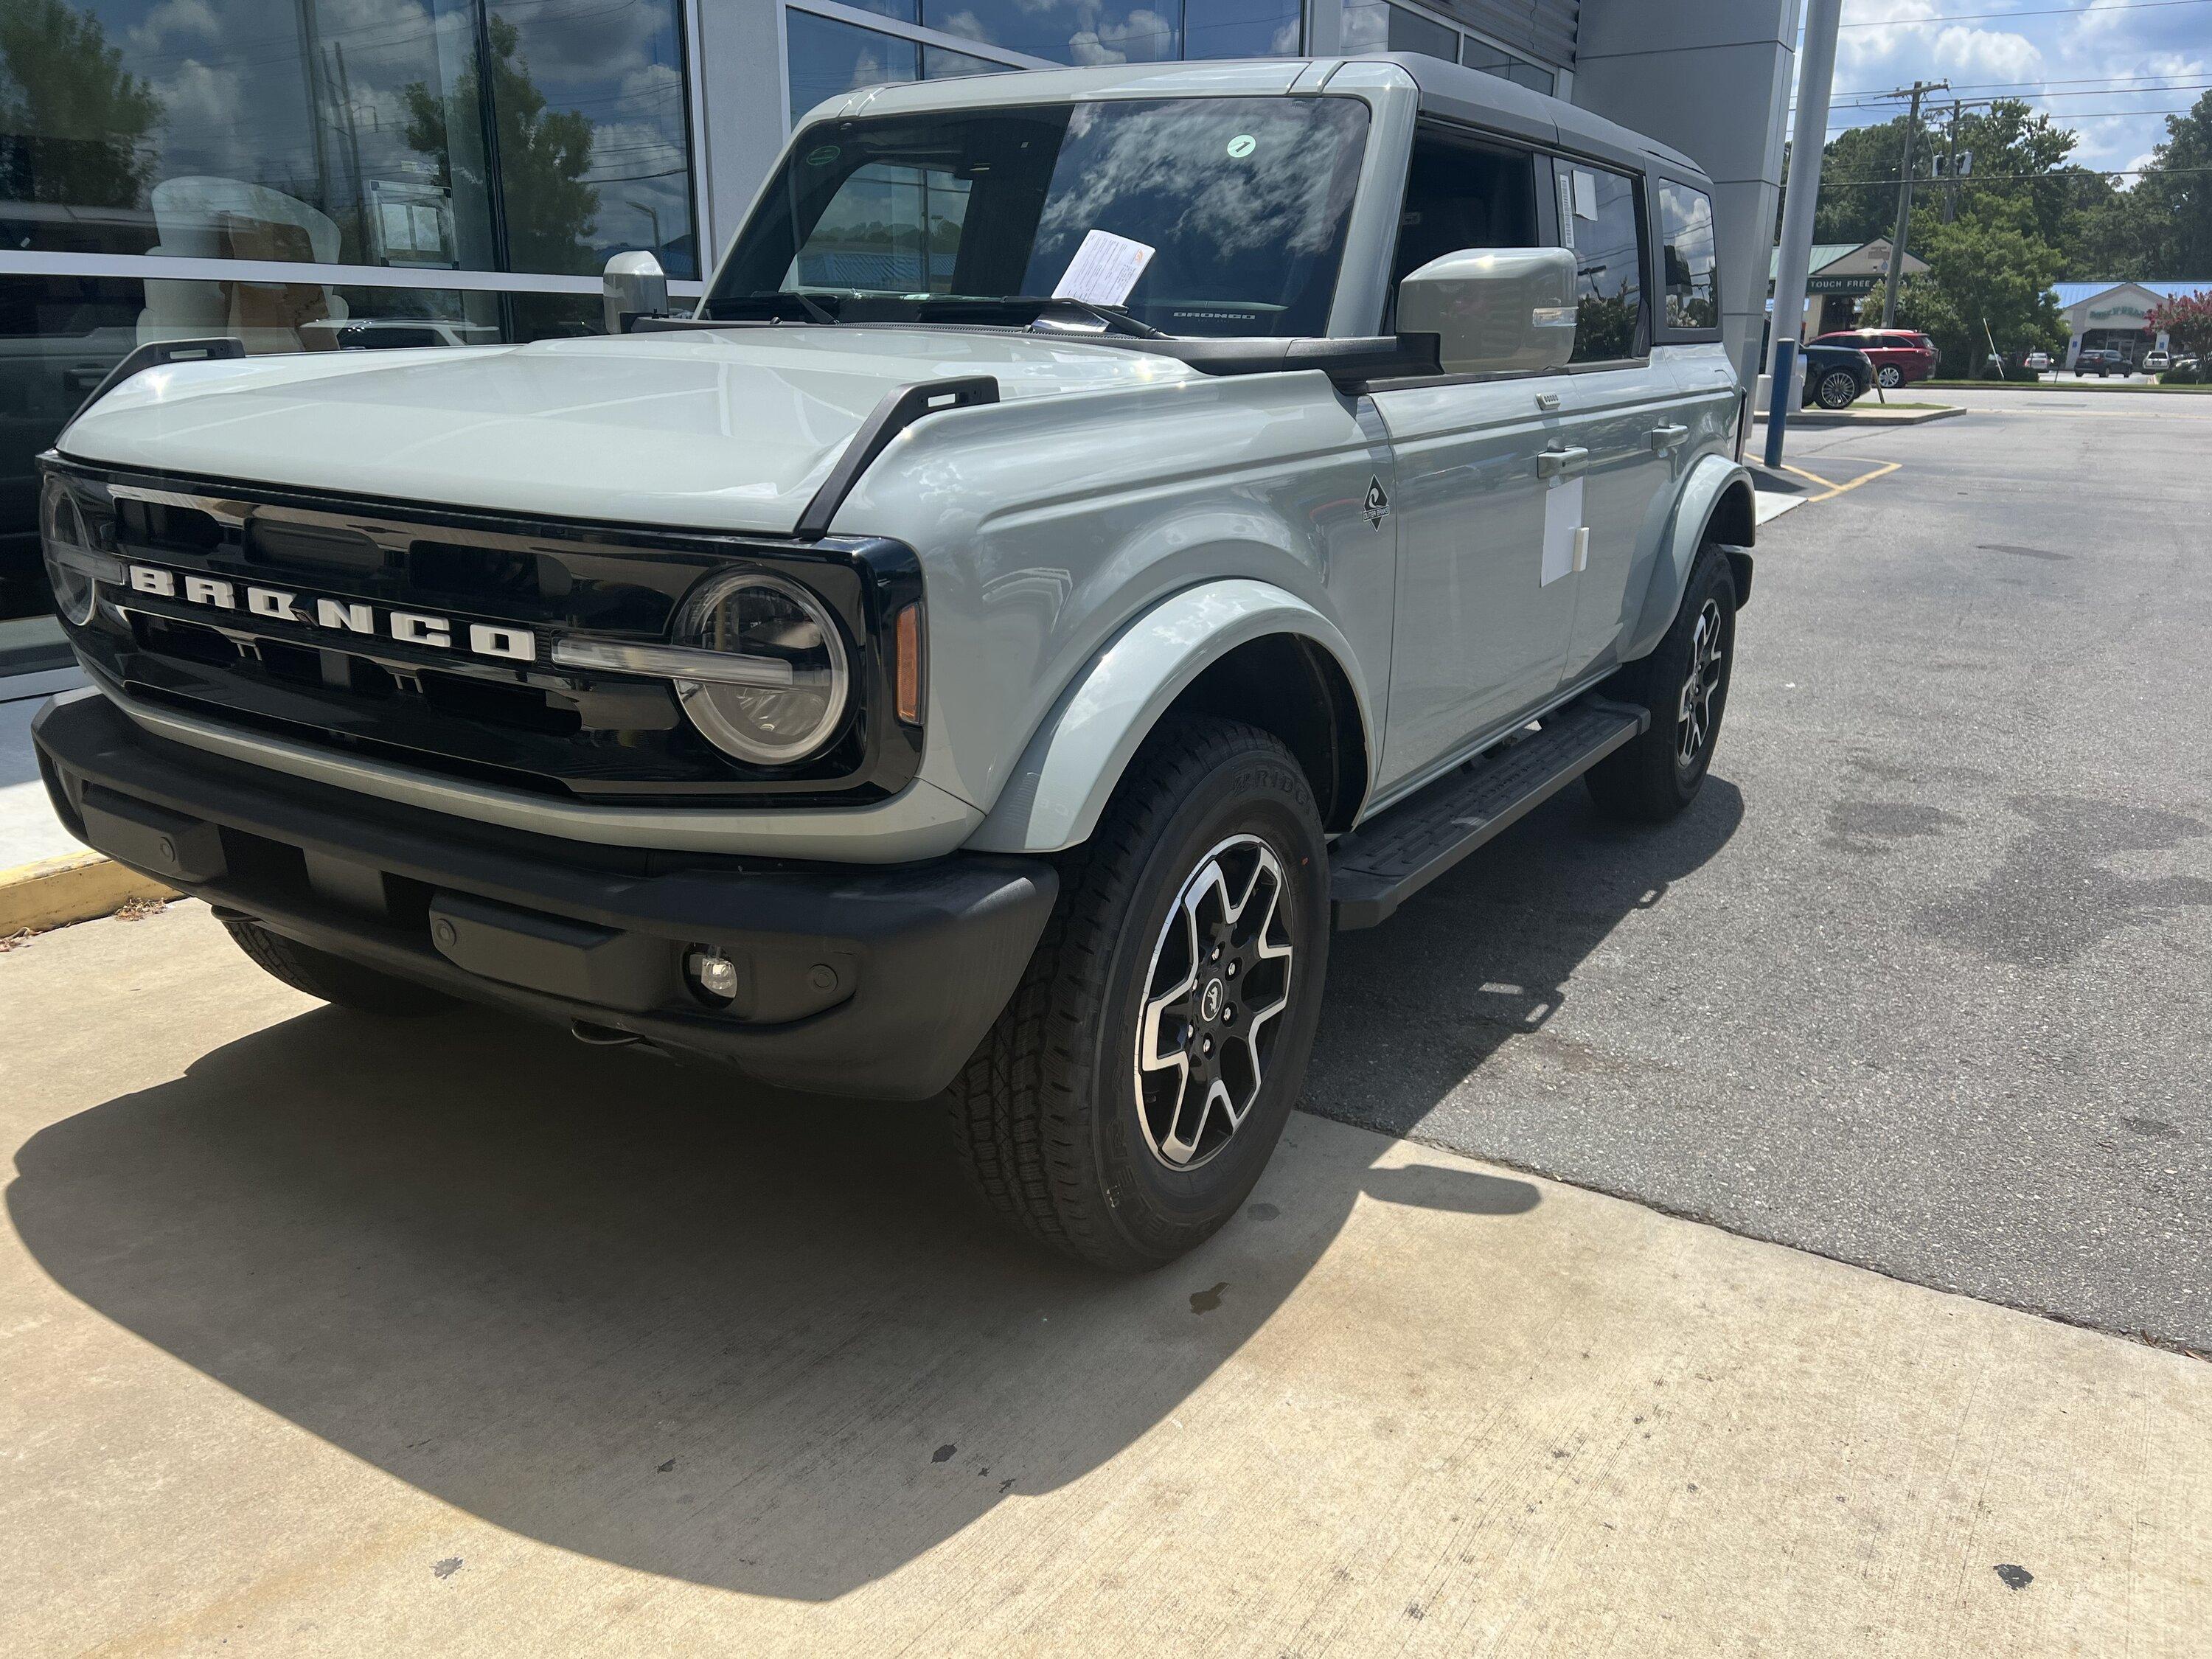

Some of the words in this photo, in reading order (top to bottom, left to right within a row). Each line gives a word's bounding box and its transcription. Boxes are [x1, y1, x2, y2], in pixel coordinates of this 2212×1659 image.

[1810, 280, 1842, 288] TOUCH
[1846, 279, 1871, 288] FREE
[130, 565, 535, 661] BRONCO
